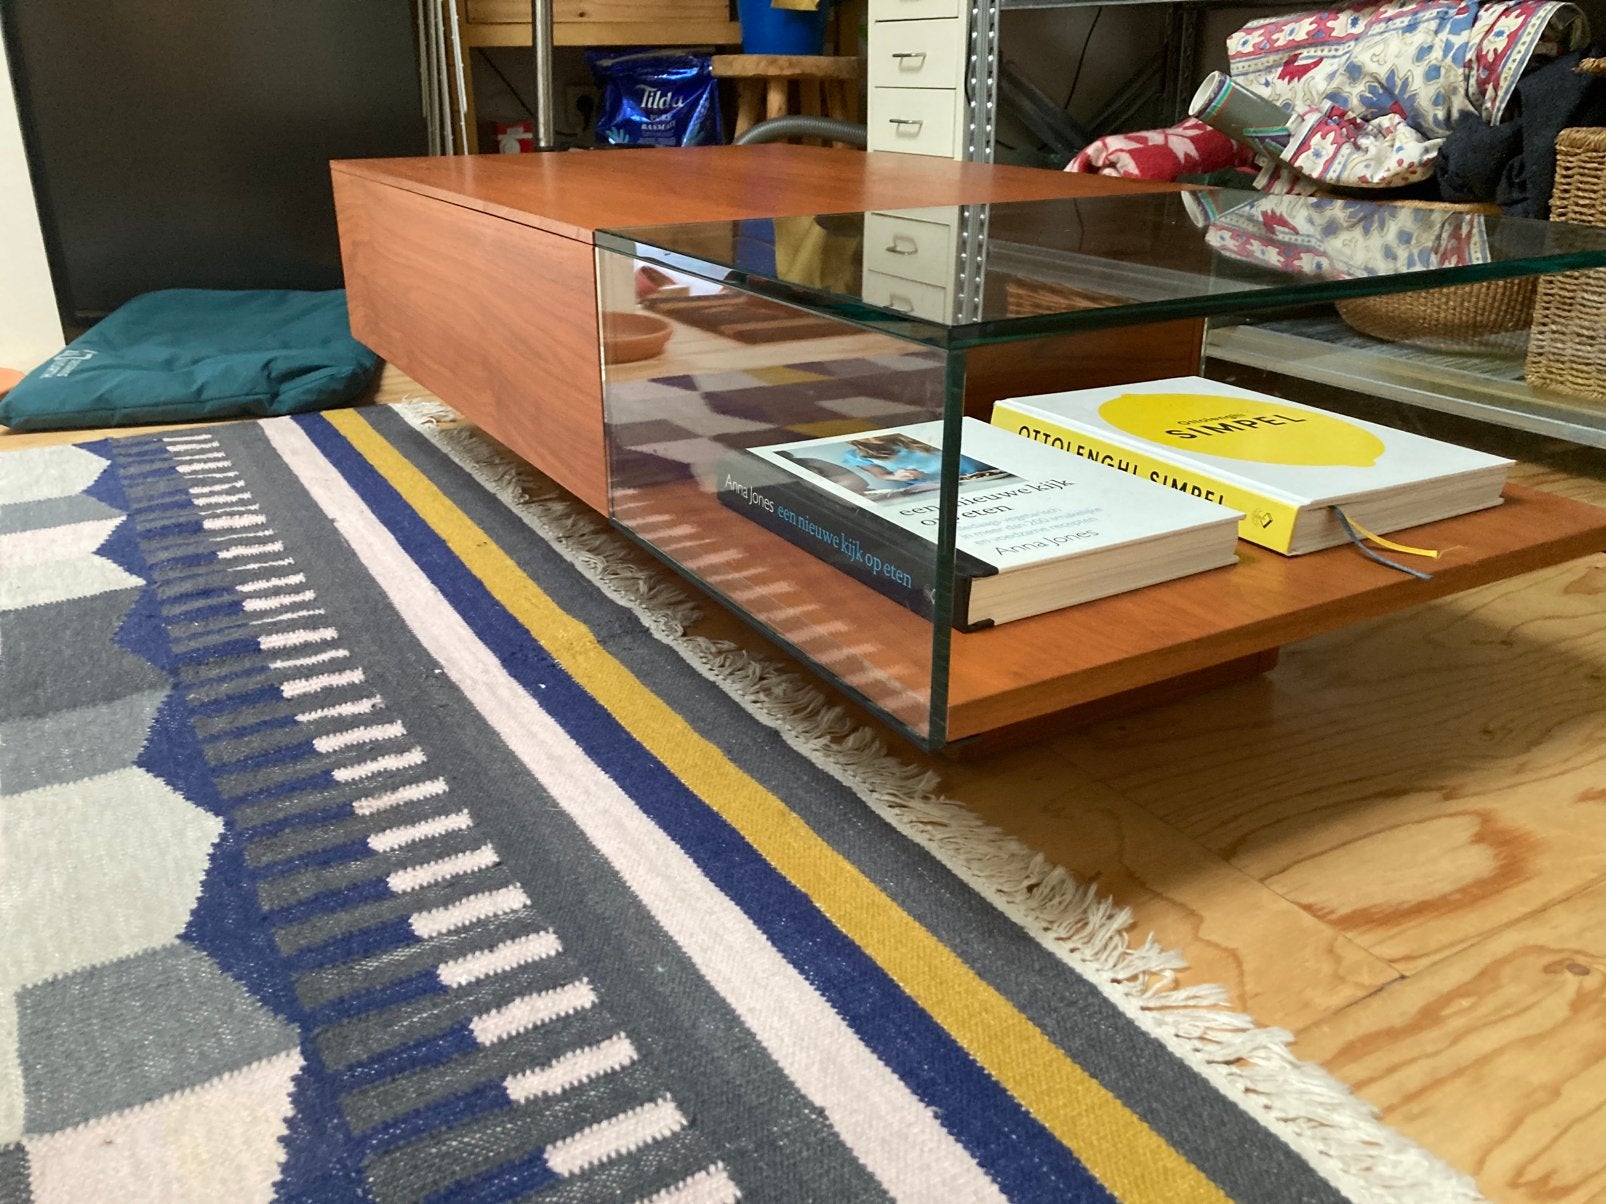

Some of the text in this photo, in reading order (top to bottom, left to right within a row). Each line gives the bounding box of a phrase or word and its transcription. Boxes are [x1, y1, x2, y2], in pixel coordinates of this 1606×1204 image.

[634, 84, 685, 109] Tilda
[1165, 414, 1306, 439] SIMPEL
[1028, 478, 1076, 493] kijk
[962, 504, 1014, 518] eten
[724, 473, 912, 589] Anna Jones een nieuwe kijk op eten
[995, 529, 1099, 556] Anna Jones
